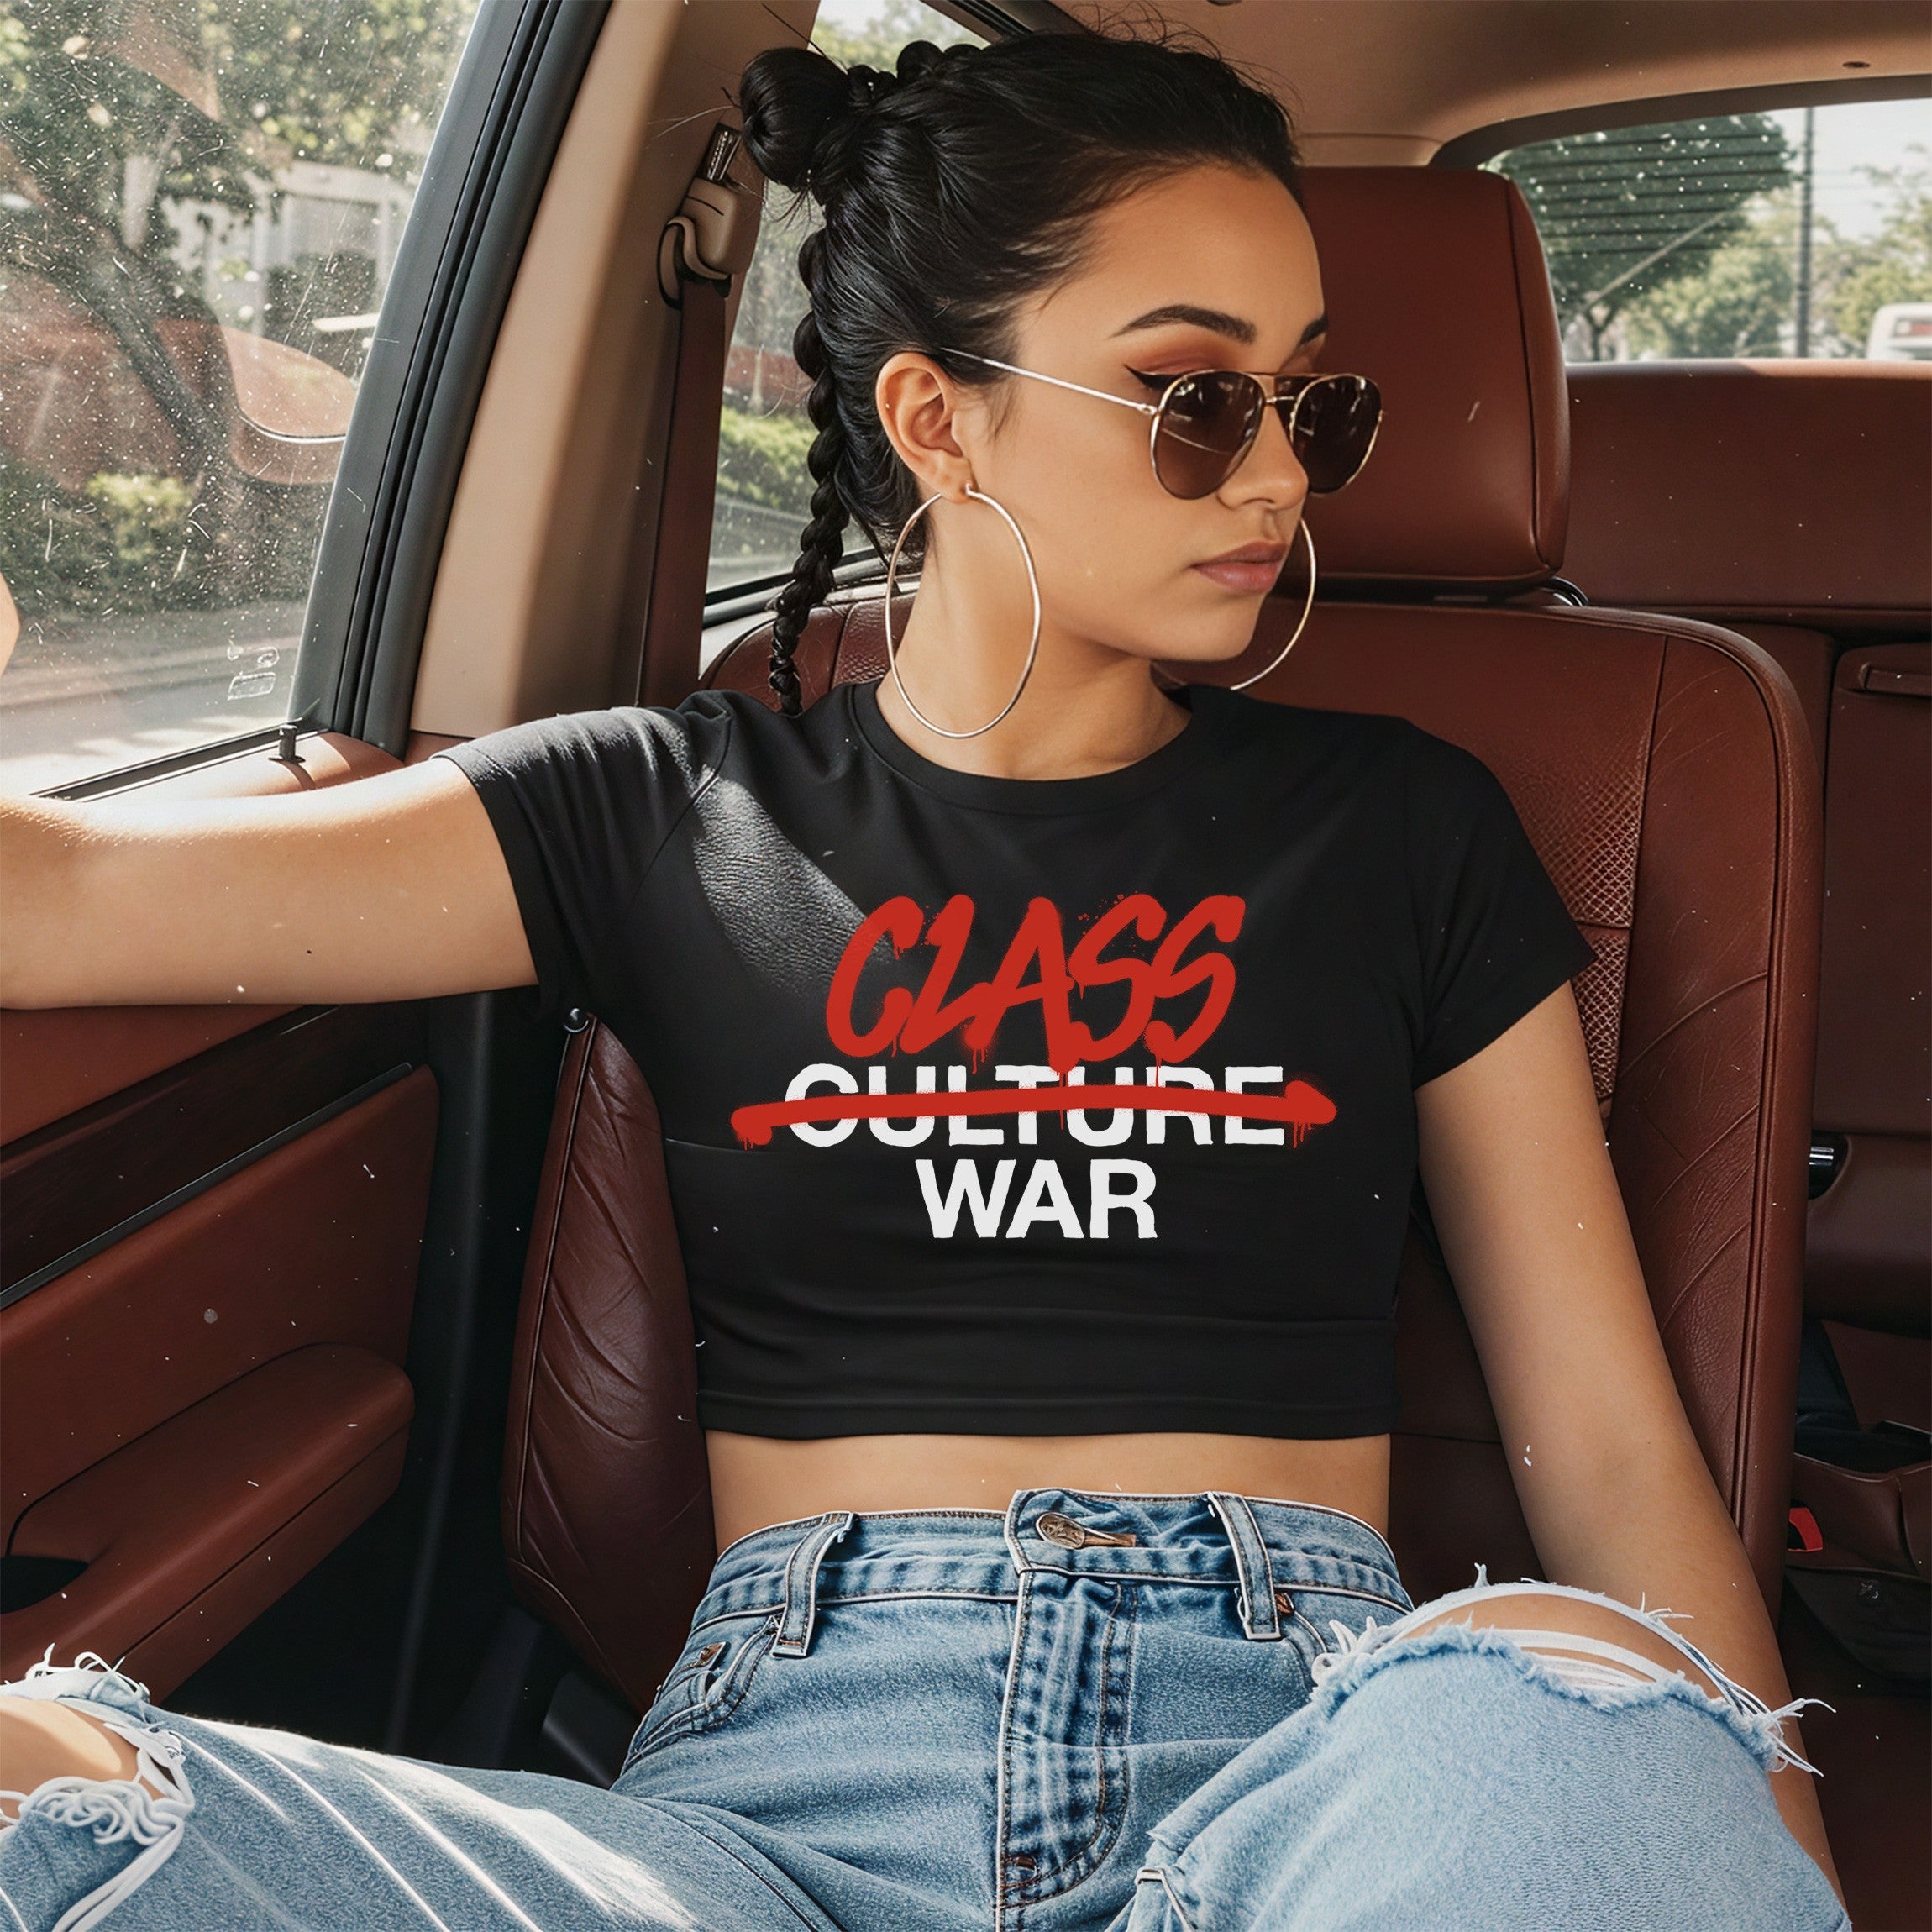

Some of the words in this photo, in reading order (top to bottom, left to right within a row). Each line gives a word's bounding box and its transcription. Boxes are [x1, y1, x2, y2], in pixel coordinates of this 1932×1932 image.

[826, 894, 1247, 1073] CLASS
[784, 1063, 1285, 1147] CULTURE
[915, 1158, 1158, 1239] WAR
